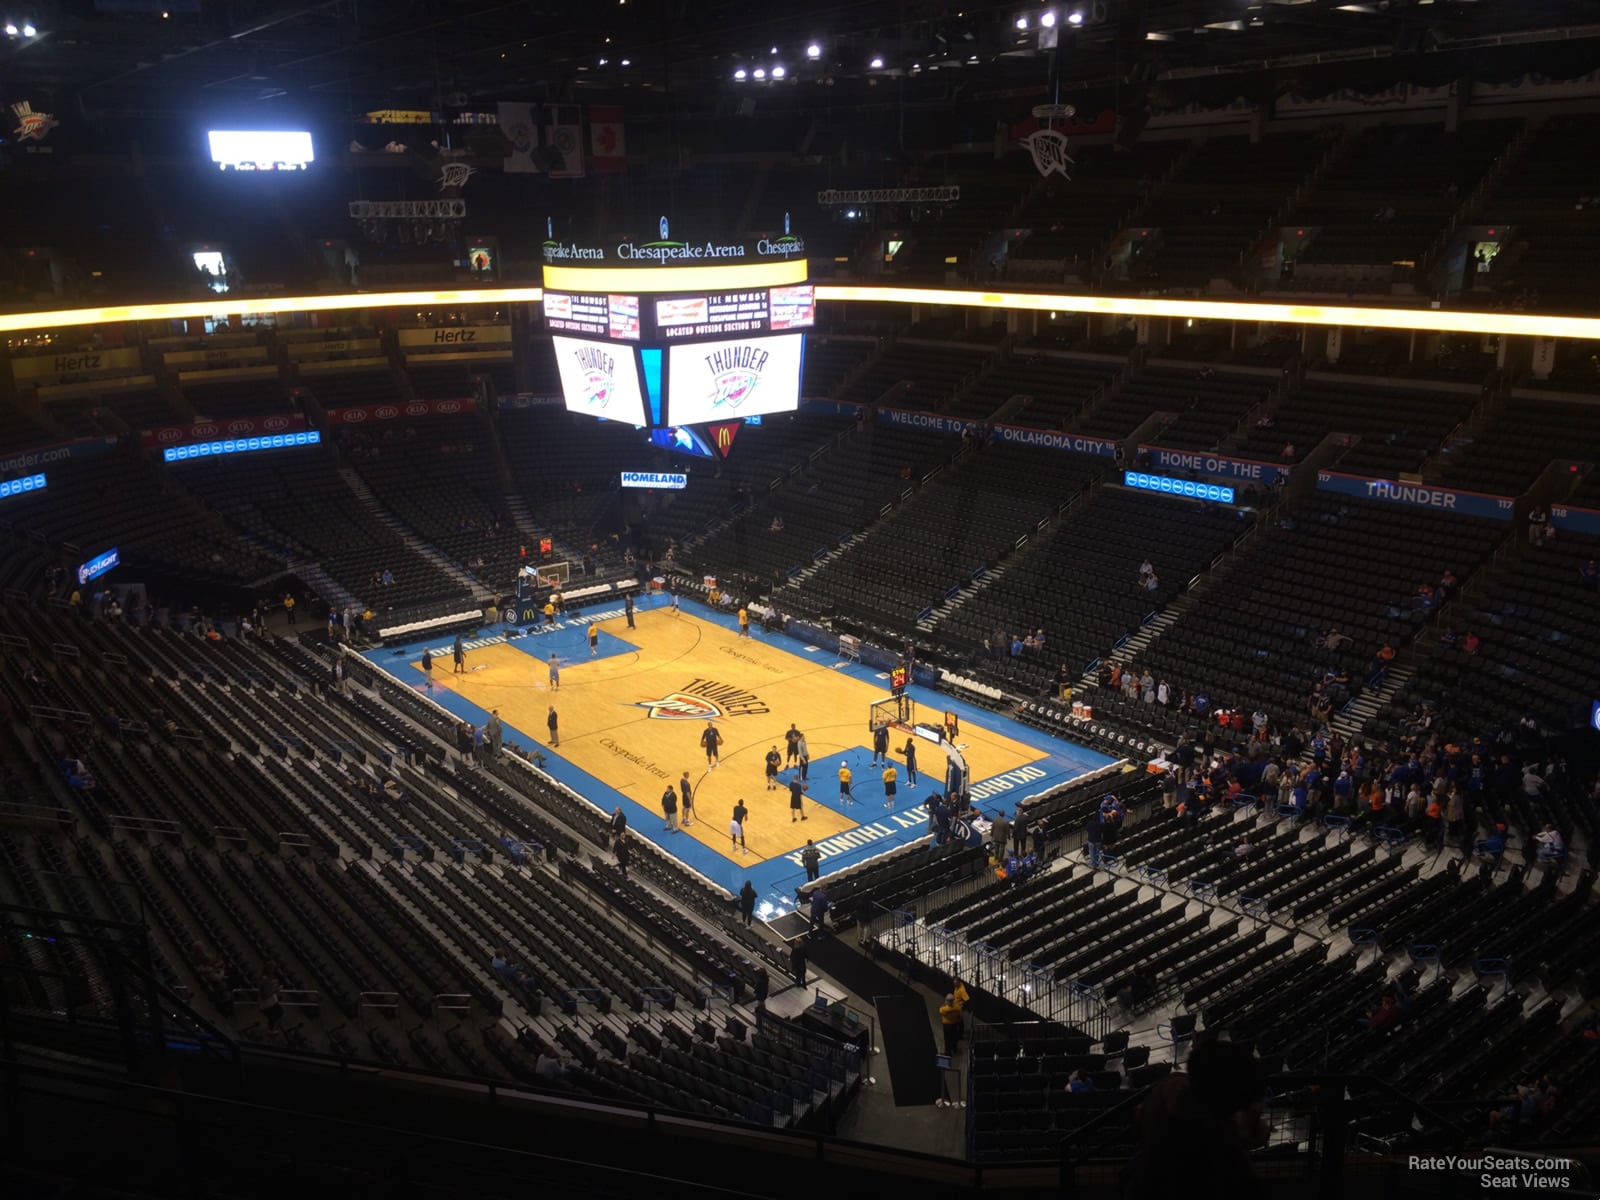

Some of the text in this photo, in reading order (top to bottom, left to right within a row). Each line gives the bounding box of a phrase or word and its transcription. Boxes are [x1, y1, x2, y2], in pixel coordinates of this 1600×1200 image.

[571, 243, 604, 259] Arena
[617, 242, 745, 264] Chesapeake Arena
[725, 292, 766, 303] NEWEST
[434, 329, 476, 343] Hertz
[666, 326, 694, 337] LOCATED
[695, 324, 722, 334] OUTSIDE
[724, 322, 749, 332] SECTION
[55, 355, 101, 372] Hertz
[574, 347, 615, 378] THUNDER
[704, 346, 769, 375] THUNDER
[890, 410, 961, 431] WELCOME TO
[1003, 428, 1071, 449] OKLAHOMA
[1074, 439, 1103, 454] CITY
[1160, 451, 1202, 470] HOME
[1206, 458, 1228, 473] OF
[1231, 461, 1262, 479] THE
[623, 472, 685, 484] HOMELAND
[1365, 481, 1457, 509] THUNDER
[1498, 499, 1514, 509] 117
[1551, 507, 1568, 518] 118
[680, 678, 770, 717] THUNDER
